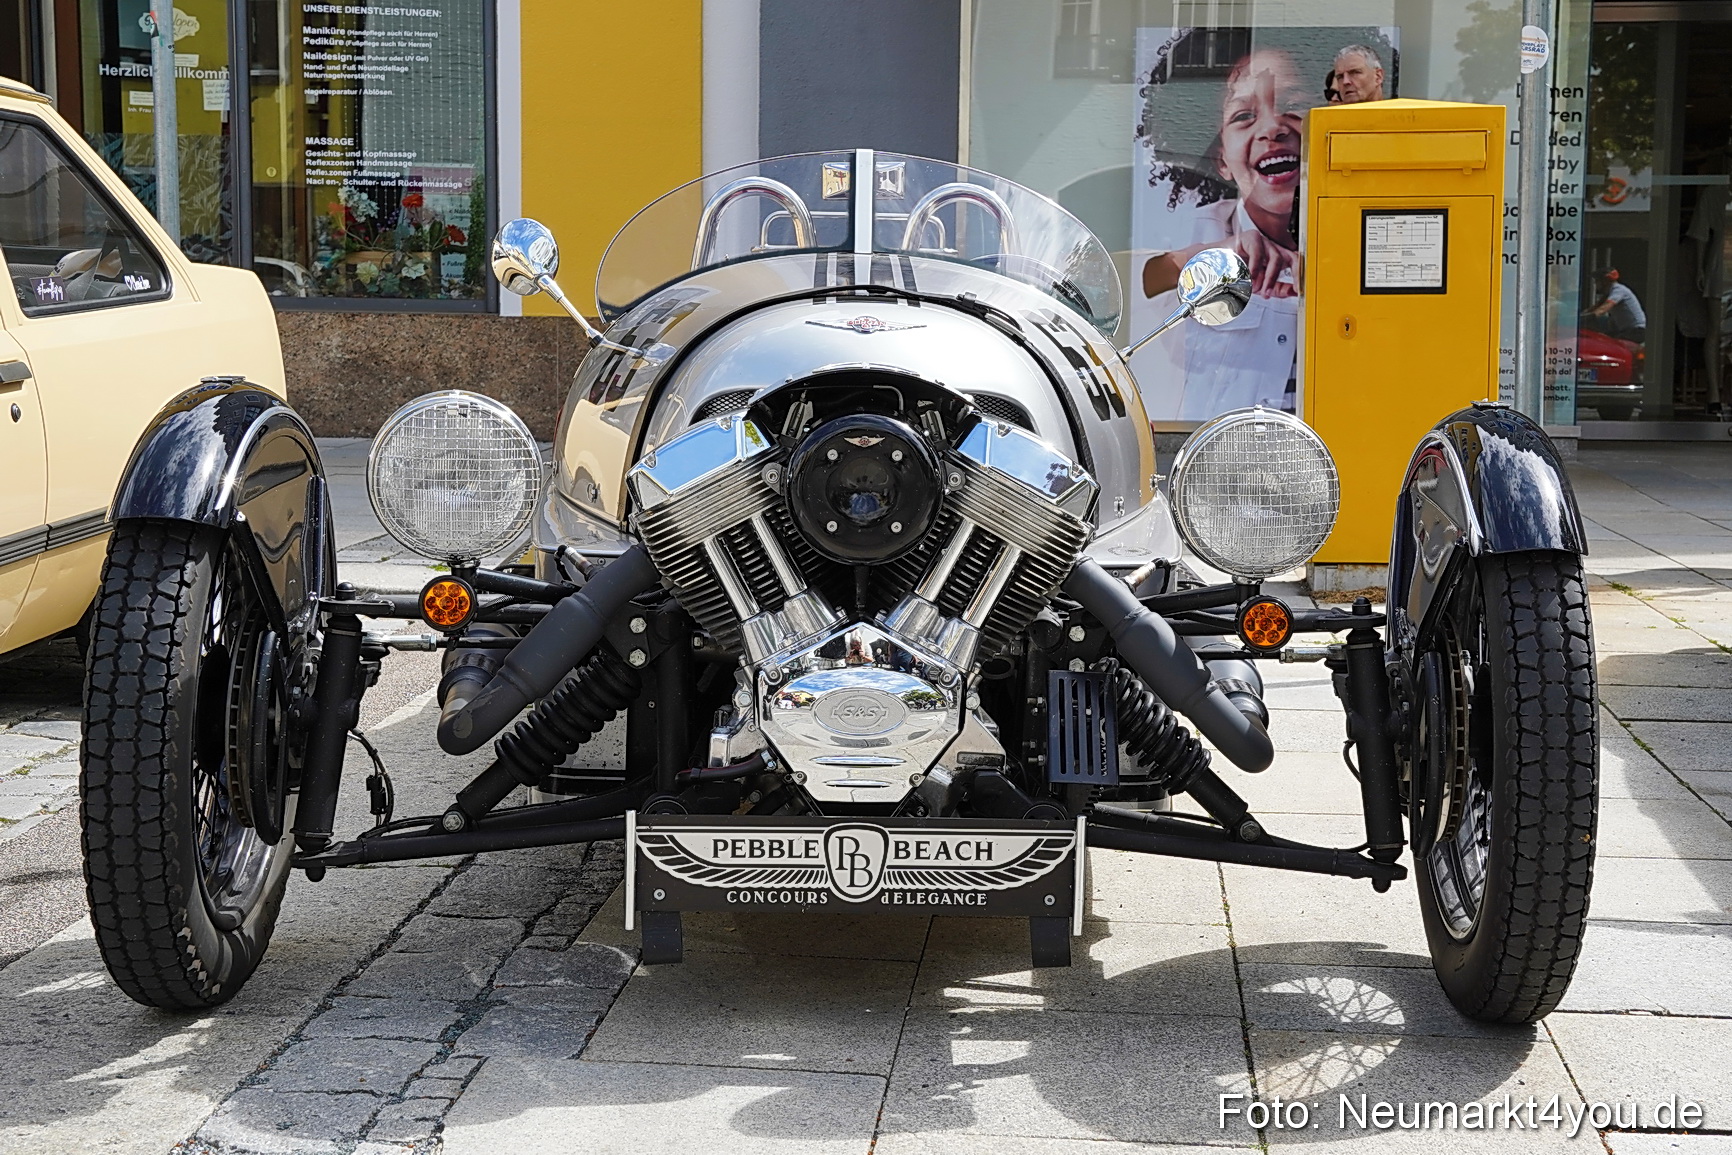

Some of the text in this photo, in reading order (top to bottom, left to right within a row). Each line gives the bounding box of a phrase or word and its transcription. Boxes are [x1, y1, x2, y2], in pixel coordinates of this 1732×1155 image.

[302, 4, 443, 18] UNSERE DIENSTLEISTUNGEN:
[302, 25, 346, 36] Maniküre
[414, 31, 439, 39] Herren)
[302, 36, 345, 46] Pediküre
[303, 51, 353, 62] Naildesign
[174, 66, 231, 80] illkomm
[357, 64, 410, 73] Neumodellage
[303, 71, 386, 81] Naturnagelverstärkung
[304, 87, 358, 97] Nagelreparatur
[363, 88, 393, 96] Ablösen
[304, 136, 355, 146] MASSAGE
[304, 149, 417, 159] Gesichts- und Kopfmassage
[305, 158, 413, 168] Reflexzonen Handmassage
[352, 169, 401, 179] Fußmassage
[342, 178, 380, 186] Schulter-
[381, 179, 397, 187] und
[397, 179, 463, 190] Rückenmassage
[1544, 385, 1572, 393] abatt.
[1544, 394, 1571, 402] ember.
[711, 838, 821, 860] PEBBLE
[892, 840, 995, 863] BEACH
[726, 889, 829, 905] CONCOURS
